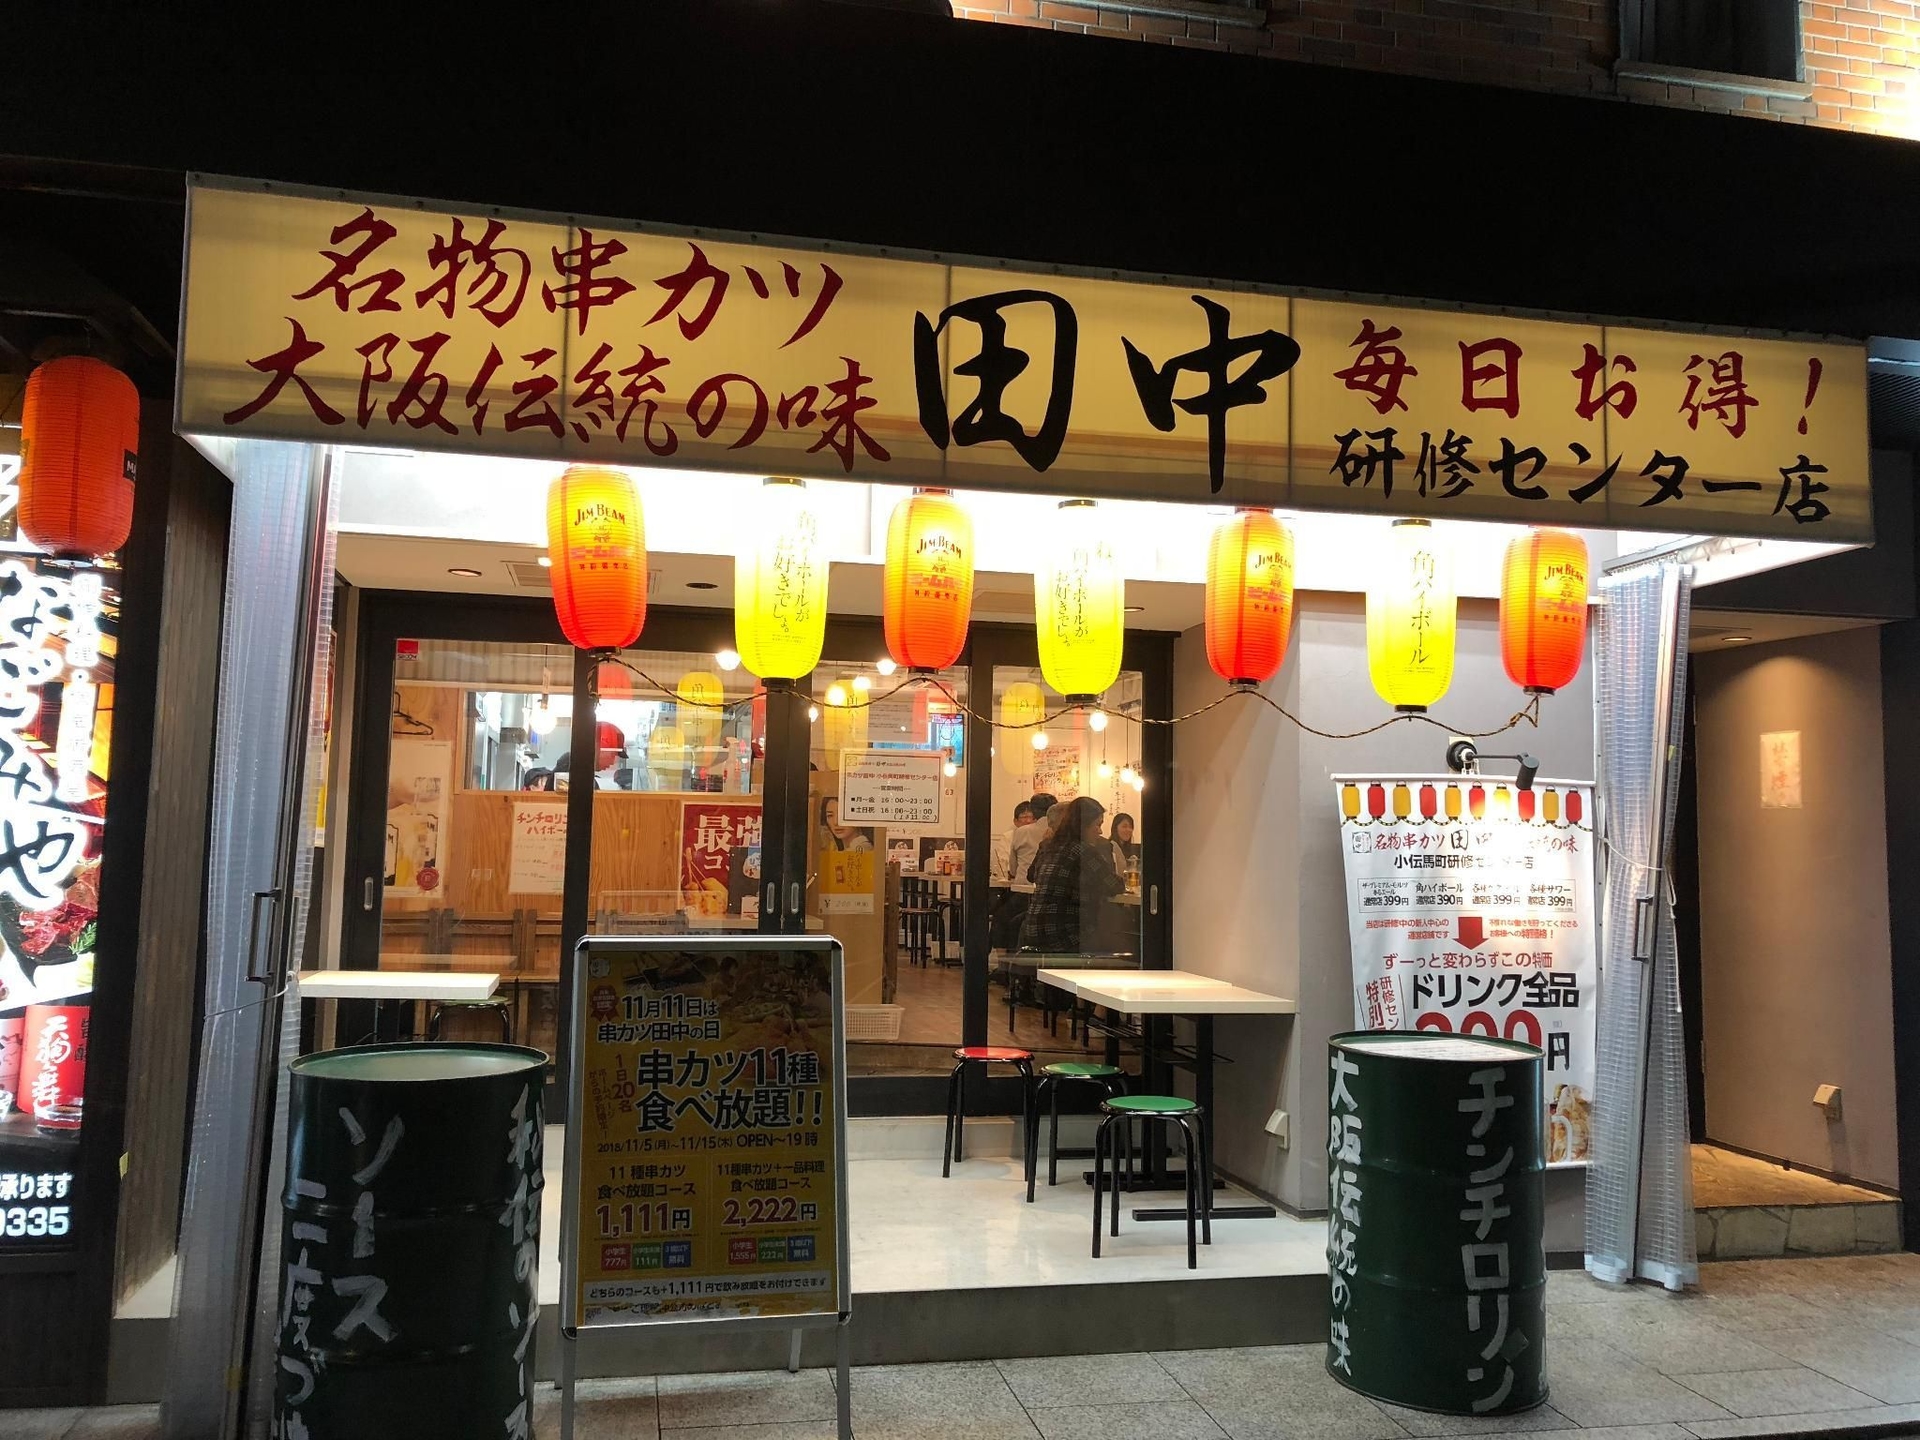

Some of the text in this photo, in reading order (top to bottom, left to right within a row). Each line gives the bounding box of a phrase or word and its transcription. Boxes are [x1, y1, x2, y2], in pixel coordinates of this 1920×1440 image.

[292, 207, 843, 349] 名物串カツ
[224, 317, 891, 473] 大阪伝統の味
[916, 291, 1301, 494] 田中
[1333, 318, 1824, 440] 毎日お得！
[1329, 427, 1834, 525] 研修センター店
[574, 507, 594, 525] JIM
[916, 537, 937, 554] JIM
[1411, 550, 1435, 664] 角ハイボール
[526, 824, 567, 835] ハイボー
[1374, 832, 1445, 851] 名物串カツ
[1383, 952, 1553, 970] ずーっと変わらずこの特価
[622, 993, 720, 1020] 11月11日は
[1412, 971, 1579, 1009] ドリンク全品
[597, 1020, 721, 1044] 串カツ田中の日
[637, 1048, 820, 1090] 串カツ11種
[597, 1177, 812, 1201] 食べ放題コース 食べ放題コース
[721, 1197, 818, 1228] 2,222円
[1329, 1050, 1362, 1376] 大阪伝統の味
[1457, 1067, 1514, 1413] チンチロリン
